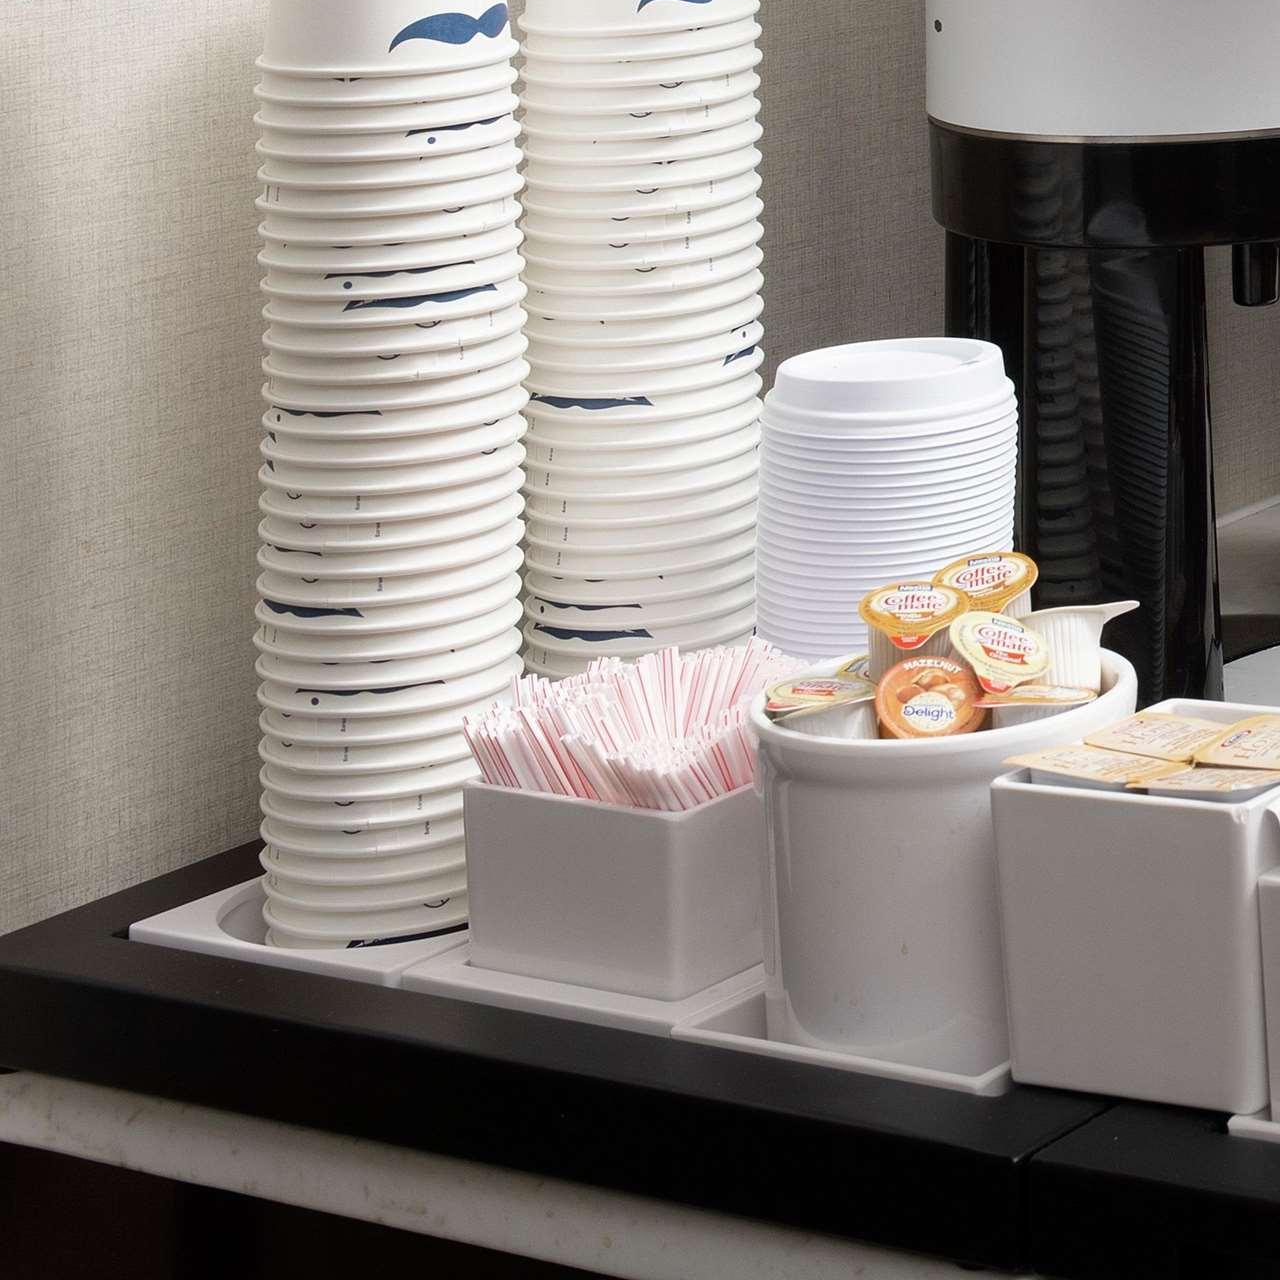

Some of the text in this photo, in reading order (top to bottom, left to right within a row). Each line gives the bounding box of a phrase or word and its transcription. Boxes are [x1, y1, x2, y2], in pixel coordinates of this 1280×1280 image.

[955, 564, 1007, 588] Coffee
[969, 570, 1012, 589] mate
[884, 594, 937, 608] Coffee
[898, 601, 942, 610] mate
[978, 626, 1029, 642] Coffee
[990, 639, 1033, 652] mate
[903, 658, 963, 674] HAZELNUT
[903, 705, 955, 721] Delight
